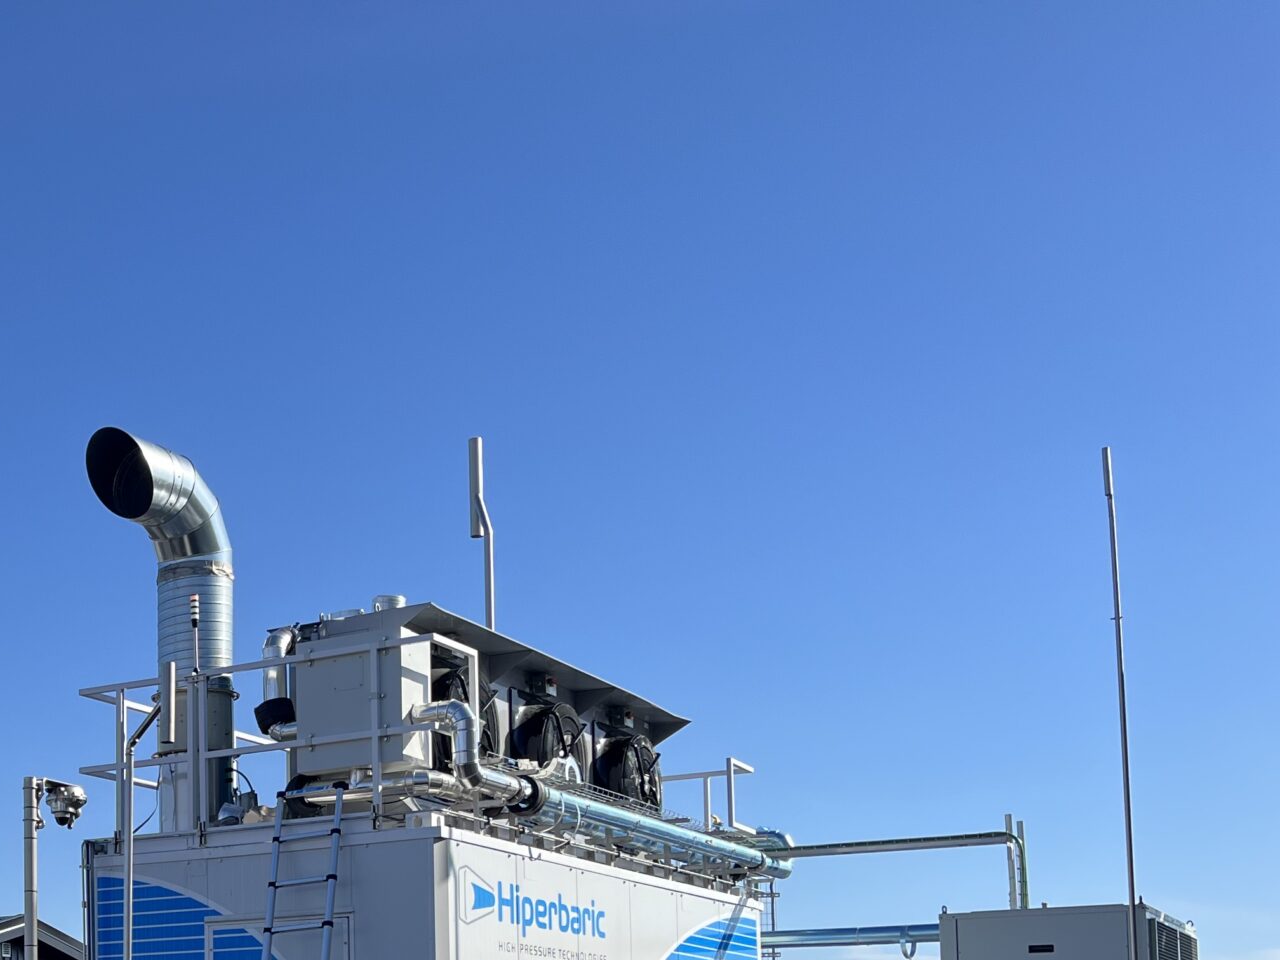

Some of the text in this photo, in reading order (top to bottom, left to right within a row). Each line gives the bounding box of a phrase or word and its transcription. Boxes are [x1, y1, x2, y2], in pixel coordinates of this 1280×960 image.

[497, 880, 606, 939] Hiperbaric
[498, 941, 516, 952] HIGH
[519, 943, 557, 959] PRESSURE
